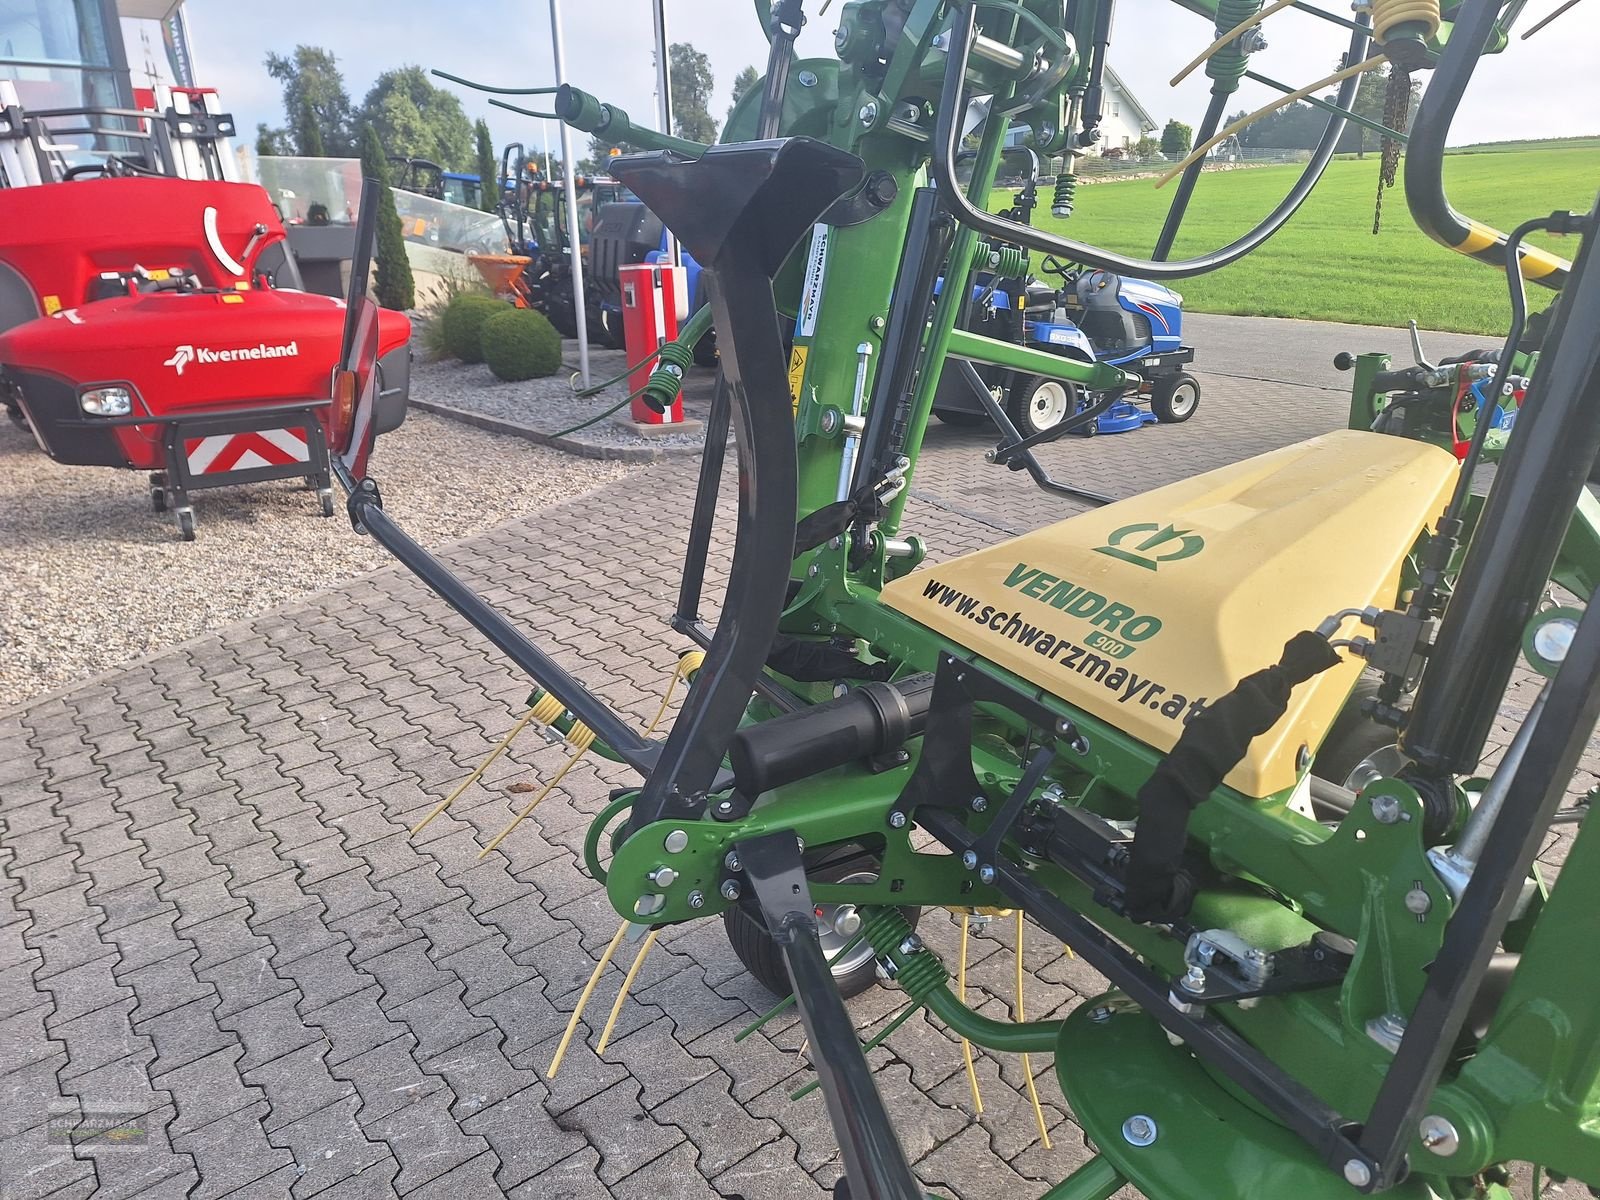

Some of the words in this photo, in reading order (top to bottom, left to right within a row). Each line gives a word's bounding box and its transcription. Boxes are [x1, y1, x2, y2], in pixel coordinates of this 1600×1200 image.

[808, 233, 827, 320] SCHWARZMAYR
[196, 341, 298, 363] Kverneland
[1003, 562, 1163, 642] VENDRO
[922, 578, 1208, 726] www.schwarzmayr.at
[1092, 636, 1125, 656] 900
